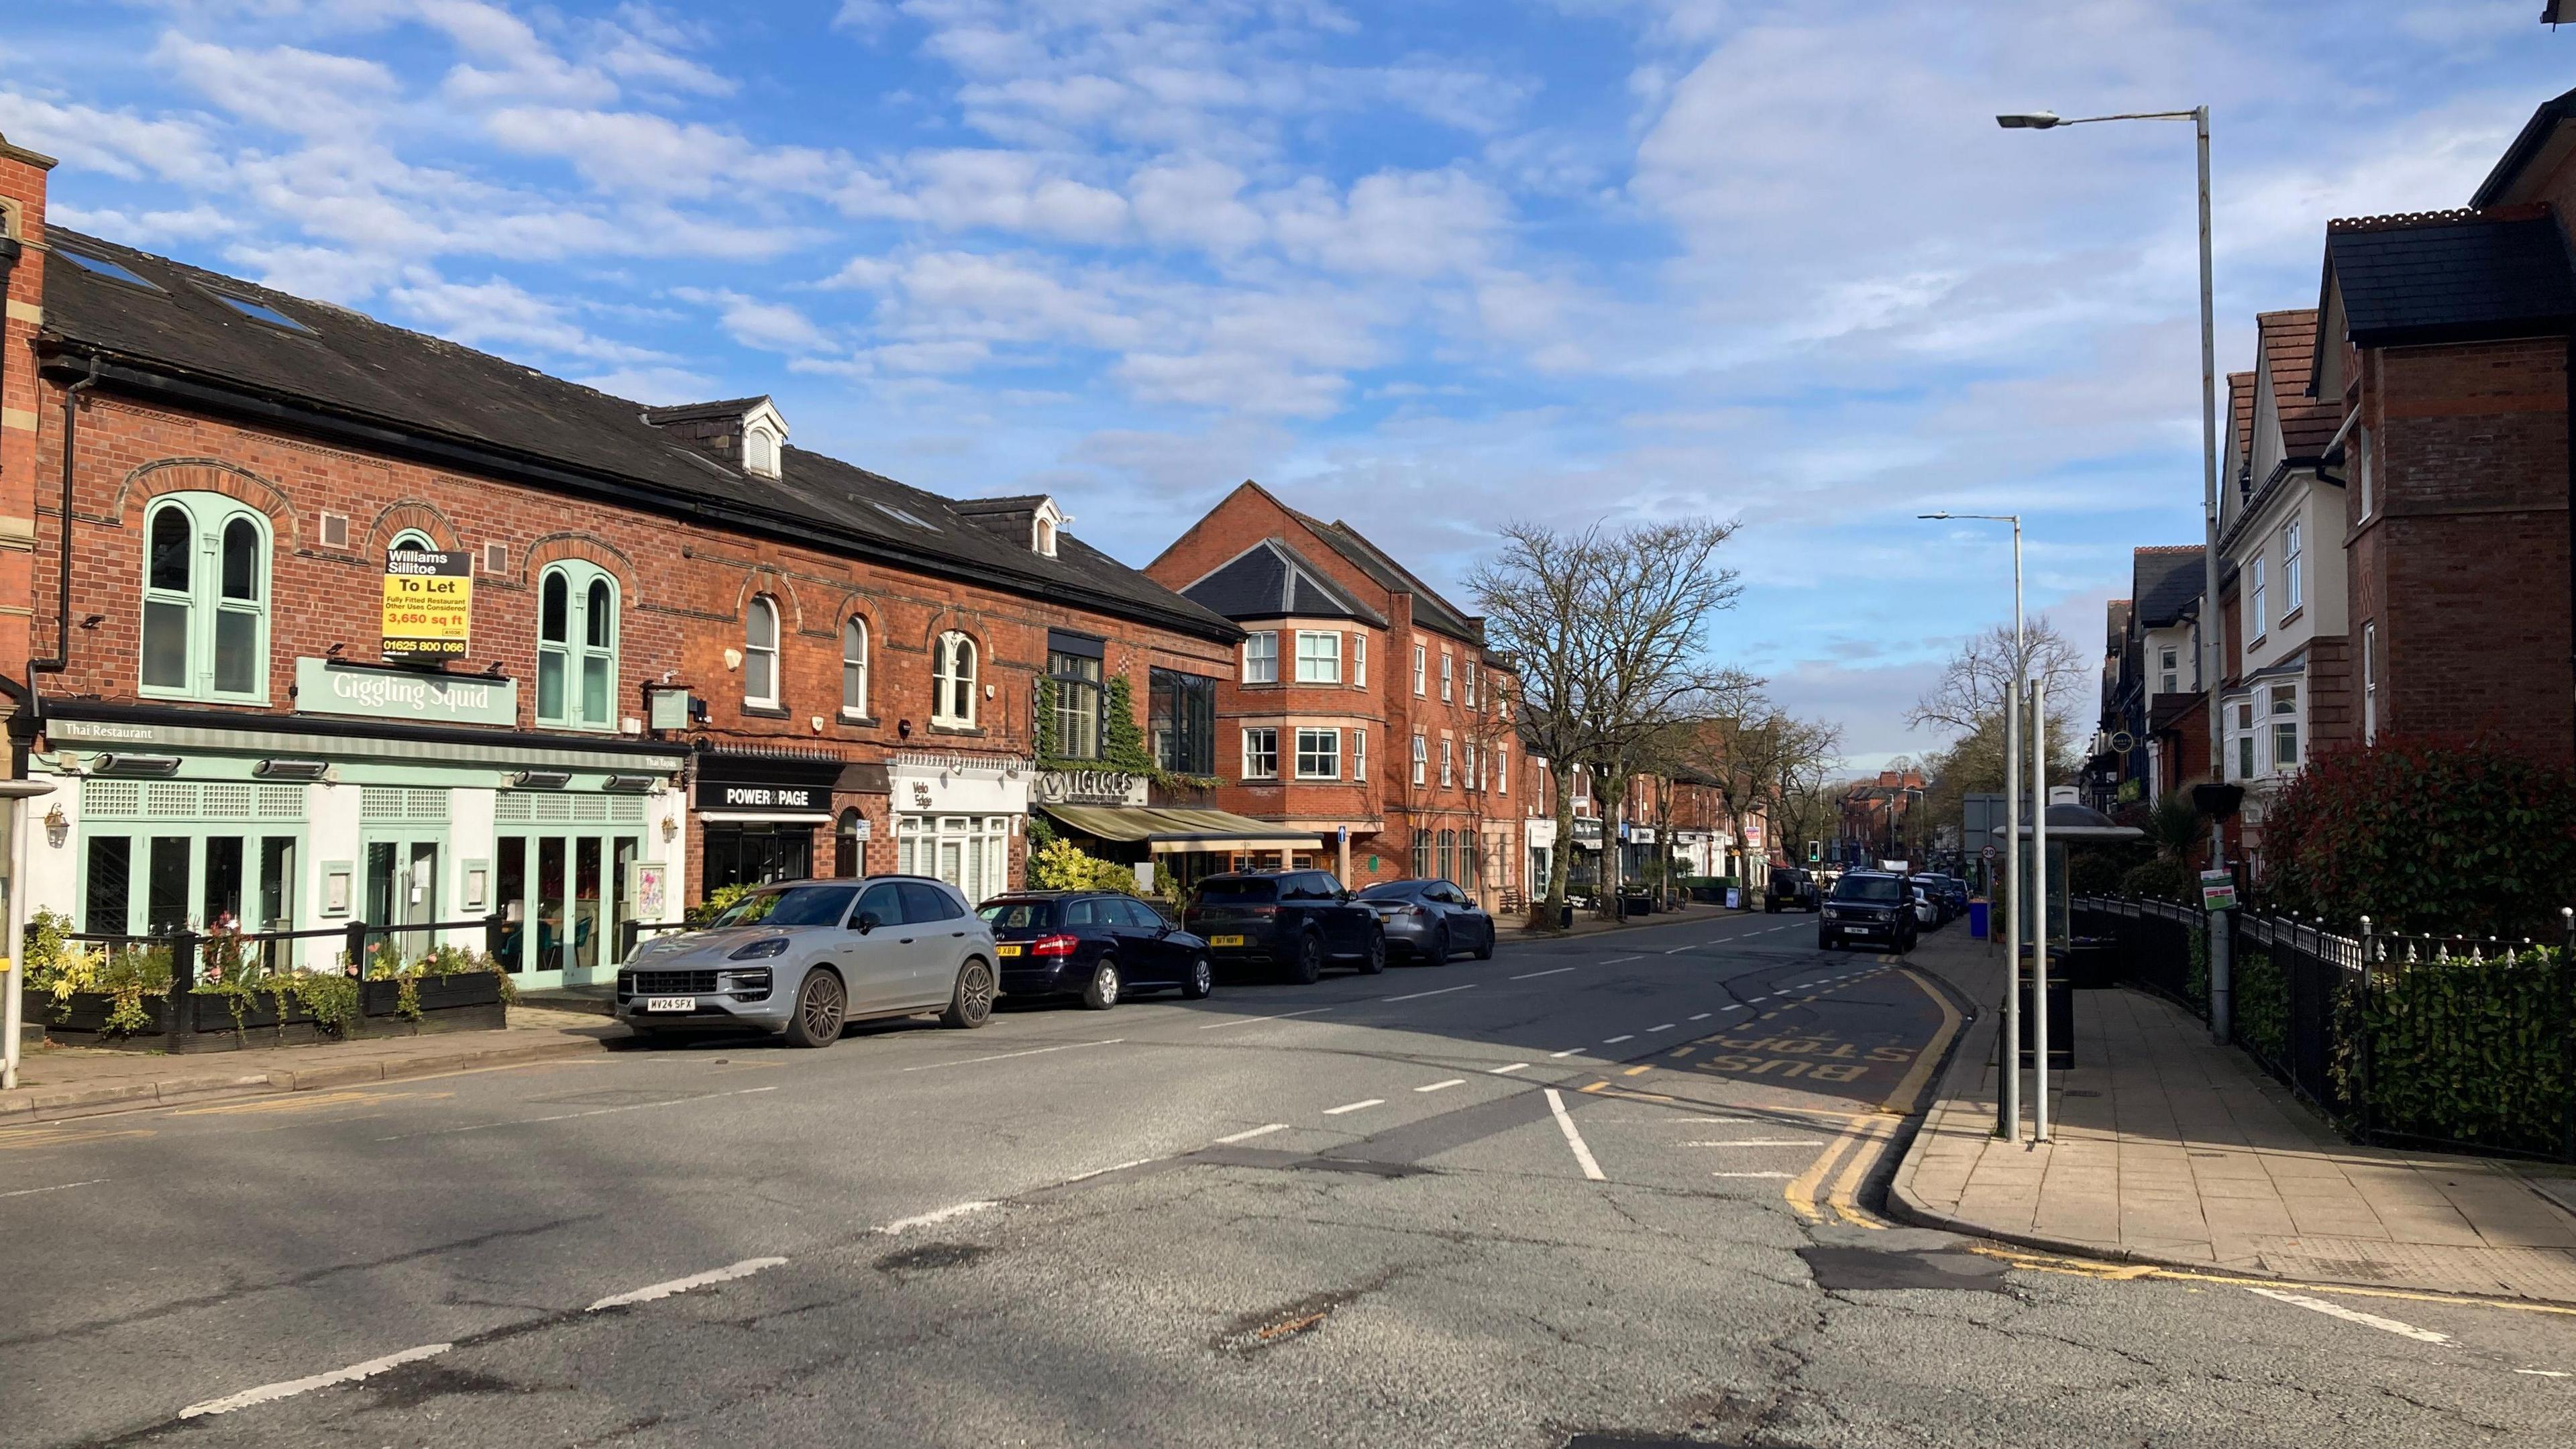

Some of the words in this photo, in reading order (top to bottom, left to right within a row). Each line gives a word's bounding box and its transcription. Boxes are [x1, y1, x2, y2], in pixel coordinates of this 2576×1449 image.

[389, 551, 448, 564] Williams
[388, 561, 437, 574] Sillitoe
[399, 579, 420, 592] To
[427, 580, 455, 593] Let
[388, 613, 427, 625] 3,650
[431, 616, 447, 627] sq
[451, 615, 462, 625] ft
[383, 640, 417, 651] 01625
[419, 641, 441, 651] 800
[443, 642, 464, 652] 066
[333, 673, 425, 710] Giggling
[430, 682, 489, 713] Squid
[65, 723, 90, 735] Thai
[93, 724, 153, 739] Restaurant
[646, 757, 659, 766] Thai
[659, 758, 677, 769] Tapas
[912, 781, 928, 794] Velo
[914, 794, 932, 810] Edge
[675, 999, 692, 1008] SFX
[1719, 1037, 1917, 1062] STOP
[1695, 1055, 1870, 1083] BUS
